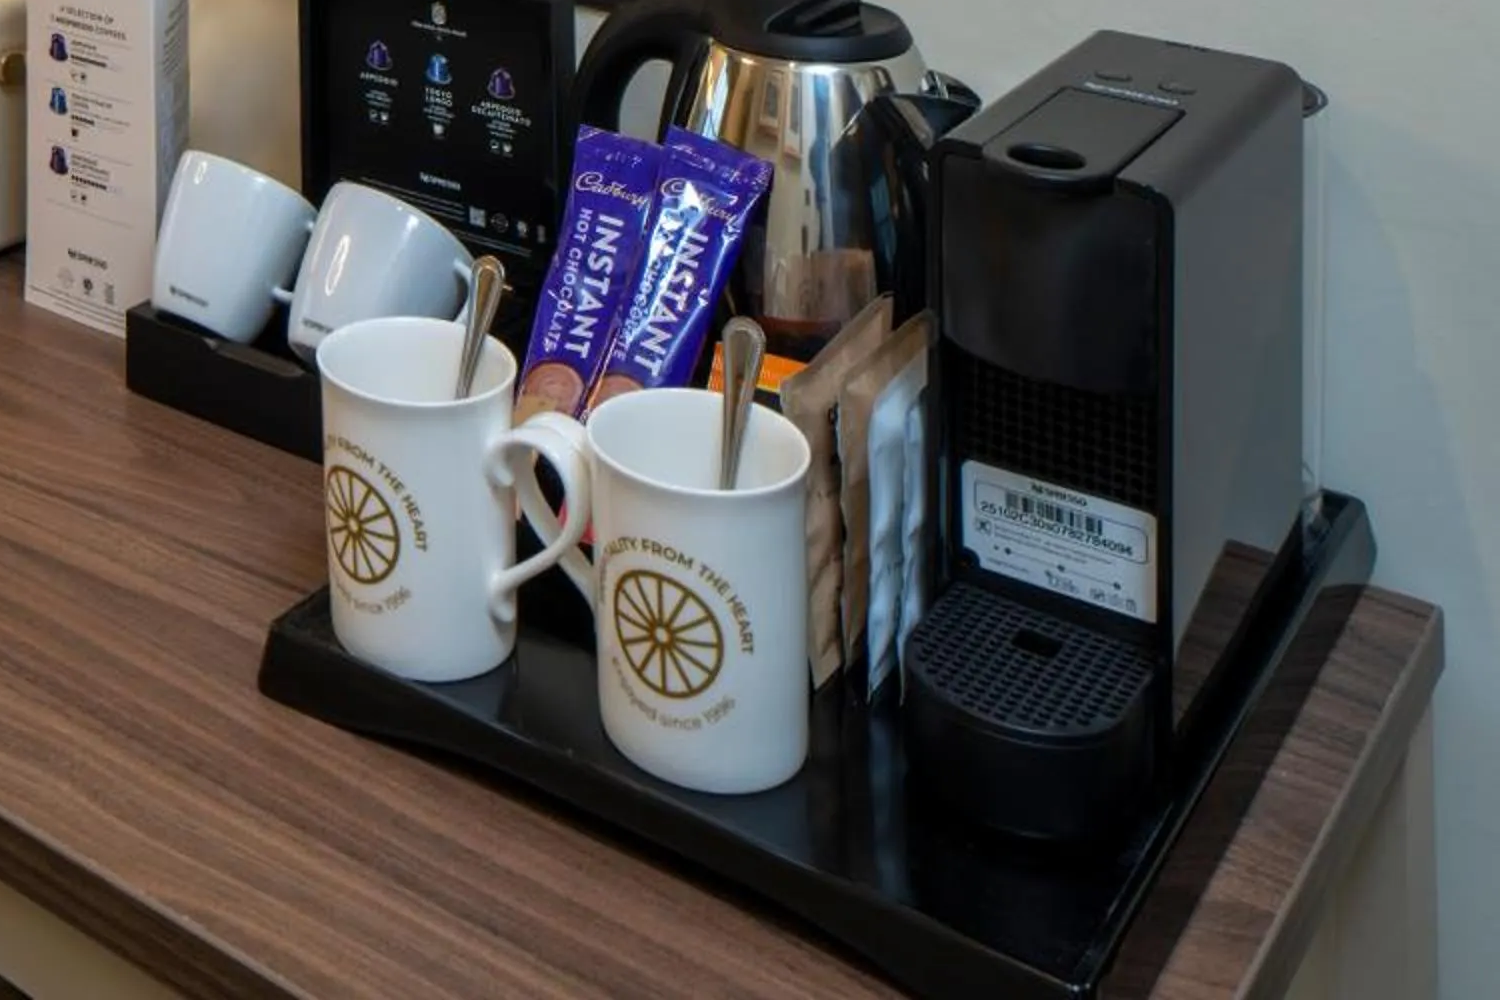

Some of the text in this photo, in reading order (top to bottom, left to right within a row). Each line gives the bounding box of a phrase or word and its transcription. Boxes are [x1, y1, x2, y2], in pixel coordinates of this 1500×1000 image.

[575, 171, 647, 212] Cadbury
[543, 207, 593, 352] HOT CHOCOLATE
[564, 214, 625, 359] INSTANT
[633, 231, 709, 377] INSTANT
[377, 461, 406, 494] THE
[401, 493, 429, 553] HEART
[641, 537, 755, 656] FROM THE HEART
